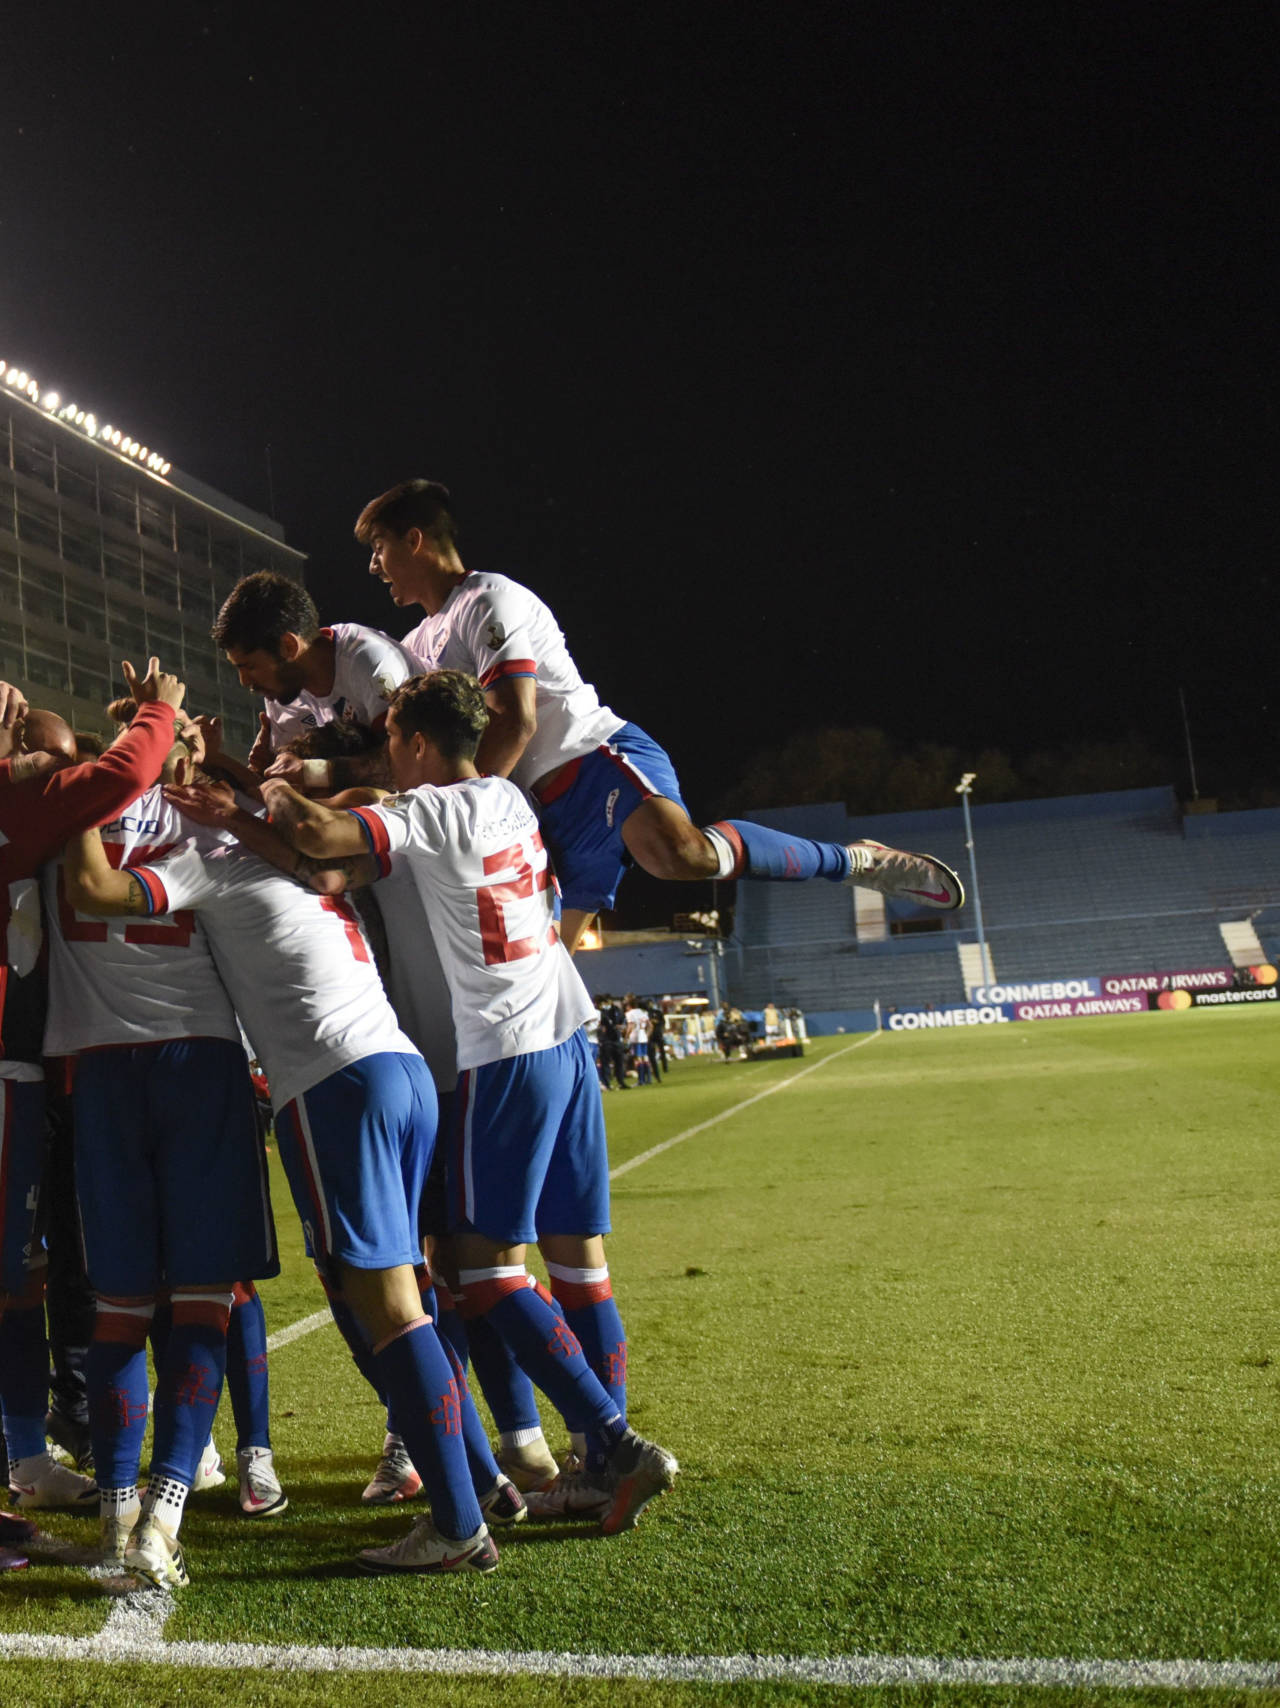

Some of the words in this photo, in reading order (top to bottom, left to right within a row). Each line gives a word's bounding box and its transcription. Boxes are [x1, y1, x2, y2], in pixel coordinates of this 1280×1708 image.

[976, 981, 1095, 1004] CONMEBOL
[1105, 977, 1158, 996] QATAR
[1196, 987, 1278, 1005] mastercard
[889, 1006, 1008, 1031] CONMEBOL
[1019, 1002, 1073, 1021] QATAR
[1075, 997, 1142, 1015] AIRWAYS
